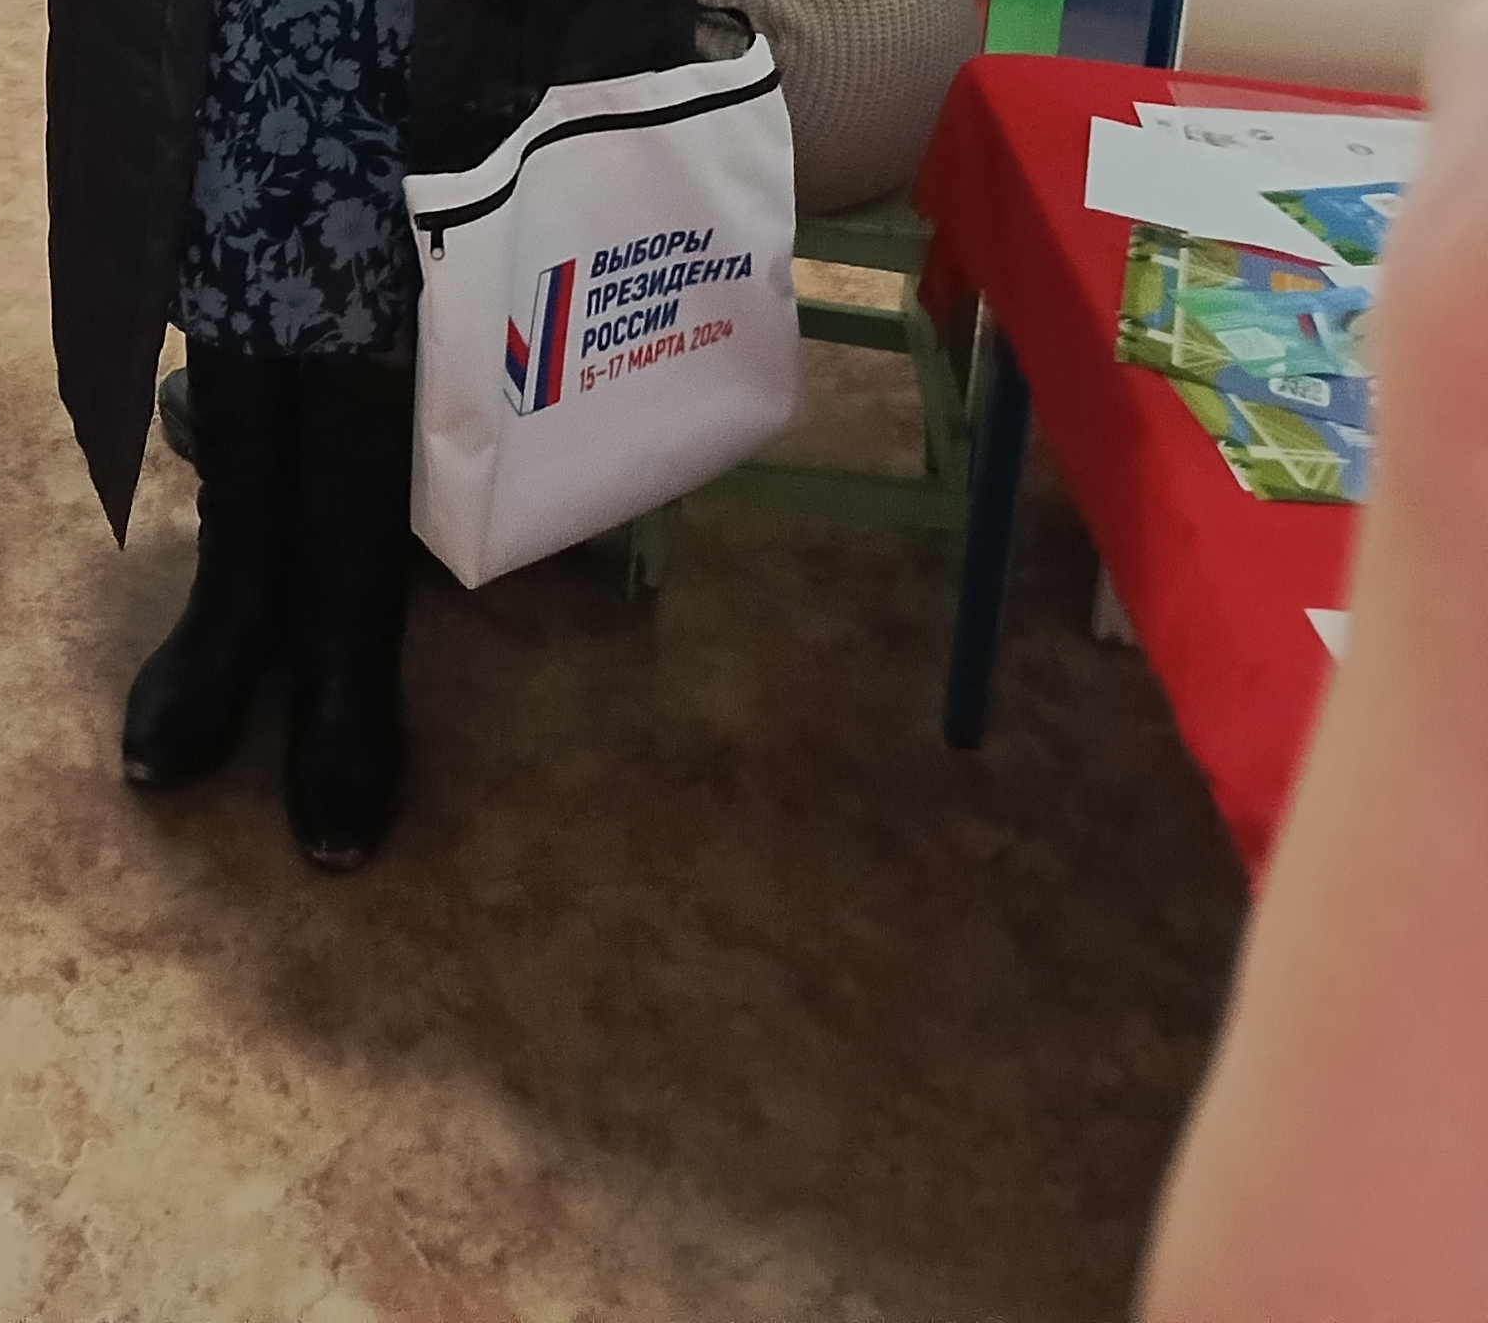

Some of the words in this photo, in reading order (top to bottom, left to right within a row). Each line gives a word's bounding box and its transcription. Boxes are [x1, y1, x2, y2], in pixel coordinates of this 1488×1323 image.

[590, 228, 714, 279] ВЫБОРЫ
[586, 252, 752, 319] ПРЕЗИДЕНТА
[581, 298, 680, 359] РОССИИ
[627, 331, 685, 375] МАРТА
[689, 319, 734, 351] 2024
